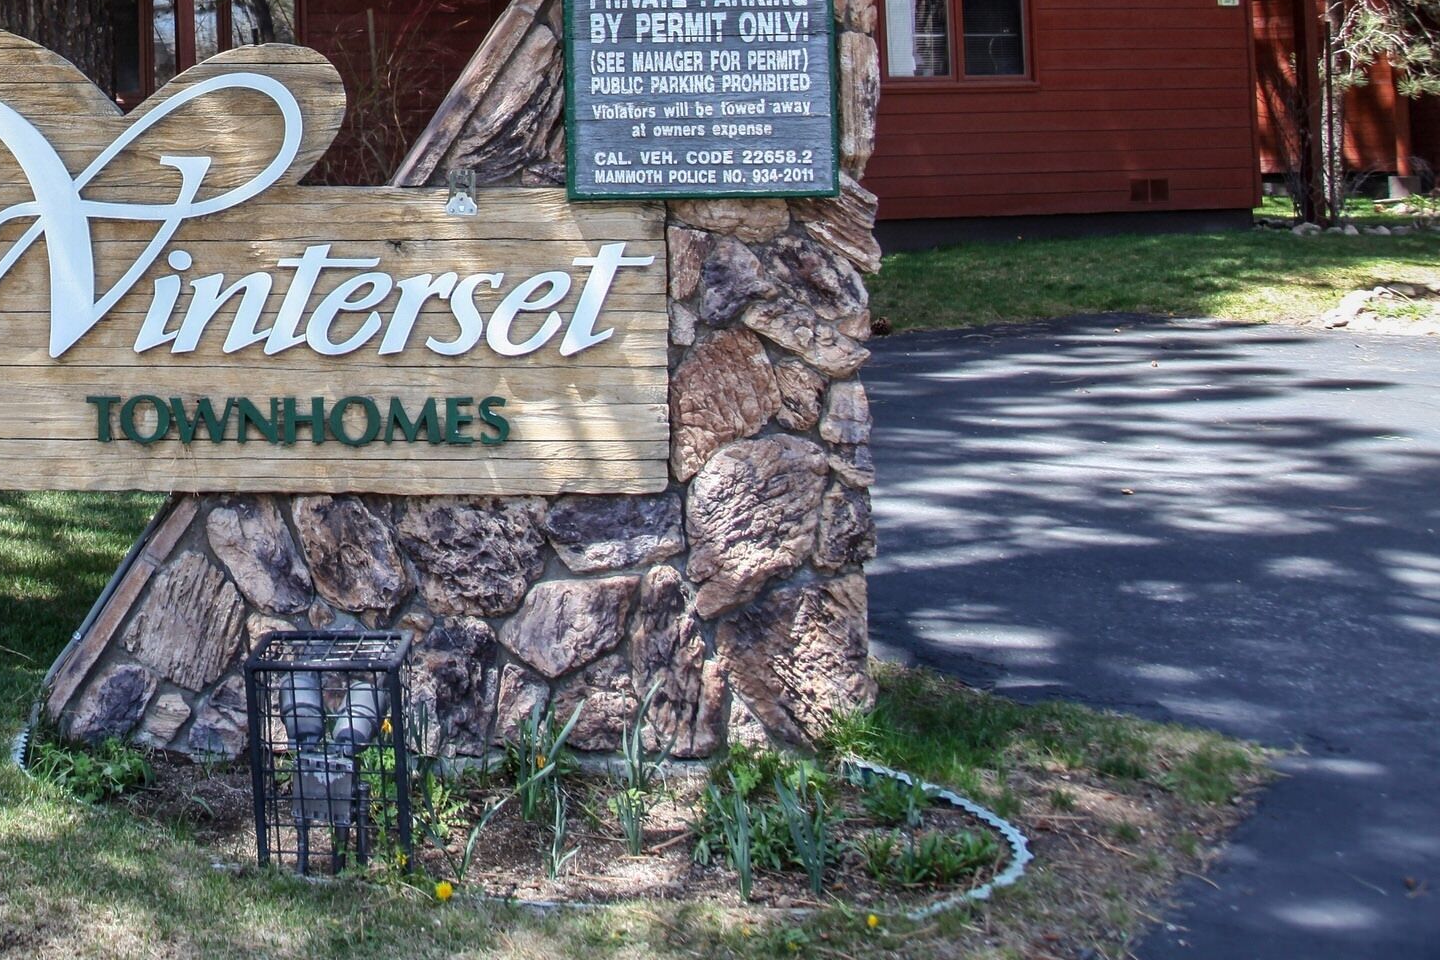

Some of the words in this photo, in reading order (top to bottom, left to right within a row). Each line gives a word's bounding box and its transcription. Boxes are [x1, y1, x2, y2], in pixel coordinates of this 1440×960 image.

[590, 13, 623, 44] BY
[635, 12, 727, 43] PERMIT
[739, 11, 809, 42] ONLY!
[590, 50, 625, 74] (SEE
[632, 50, 703, 72] MANAGER
[710, 50, 741, 71] FOR
[747, 48, 809, 72] PERMIT)
[591, 76, 644, 95] PUBLIC
[650, 74, 714, 94] PARKING
[722, 73, 810, 92] PROHIBITED
[592, 103, 656, 120] Violators
[663, 101, 689, 118] will
[695, 101, 713, 117] be
[720, 99, 765, 116] towed
[772, 100, 811, 117] away
[631, 123, 646, 137] at
[653, 124, 705, 137] owners
[712, 123, 773, 139] expense
[594, 151, 632, 166] CAL.
[640, 151, 678, 165] VEH.
[686, 150, 734, 165] CODE
[742, 150, 813, 164] 22658.2
[594, 169, 662, 184] MAMMOTH
[668, 169, 717, 183] POLICE
[723, 169, 746, 183] NO.
[752, 168, 814, 183] 934-2011
[86, 394, 511, 447] TOWNHOMES
